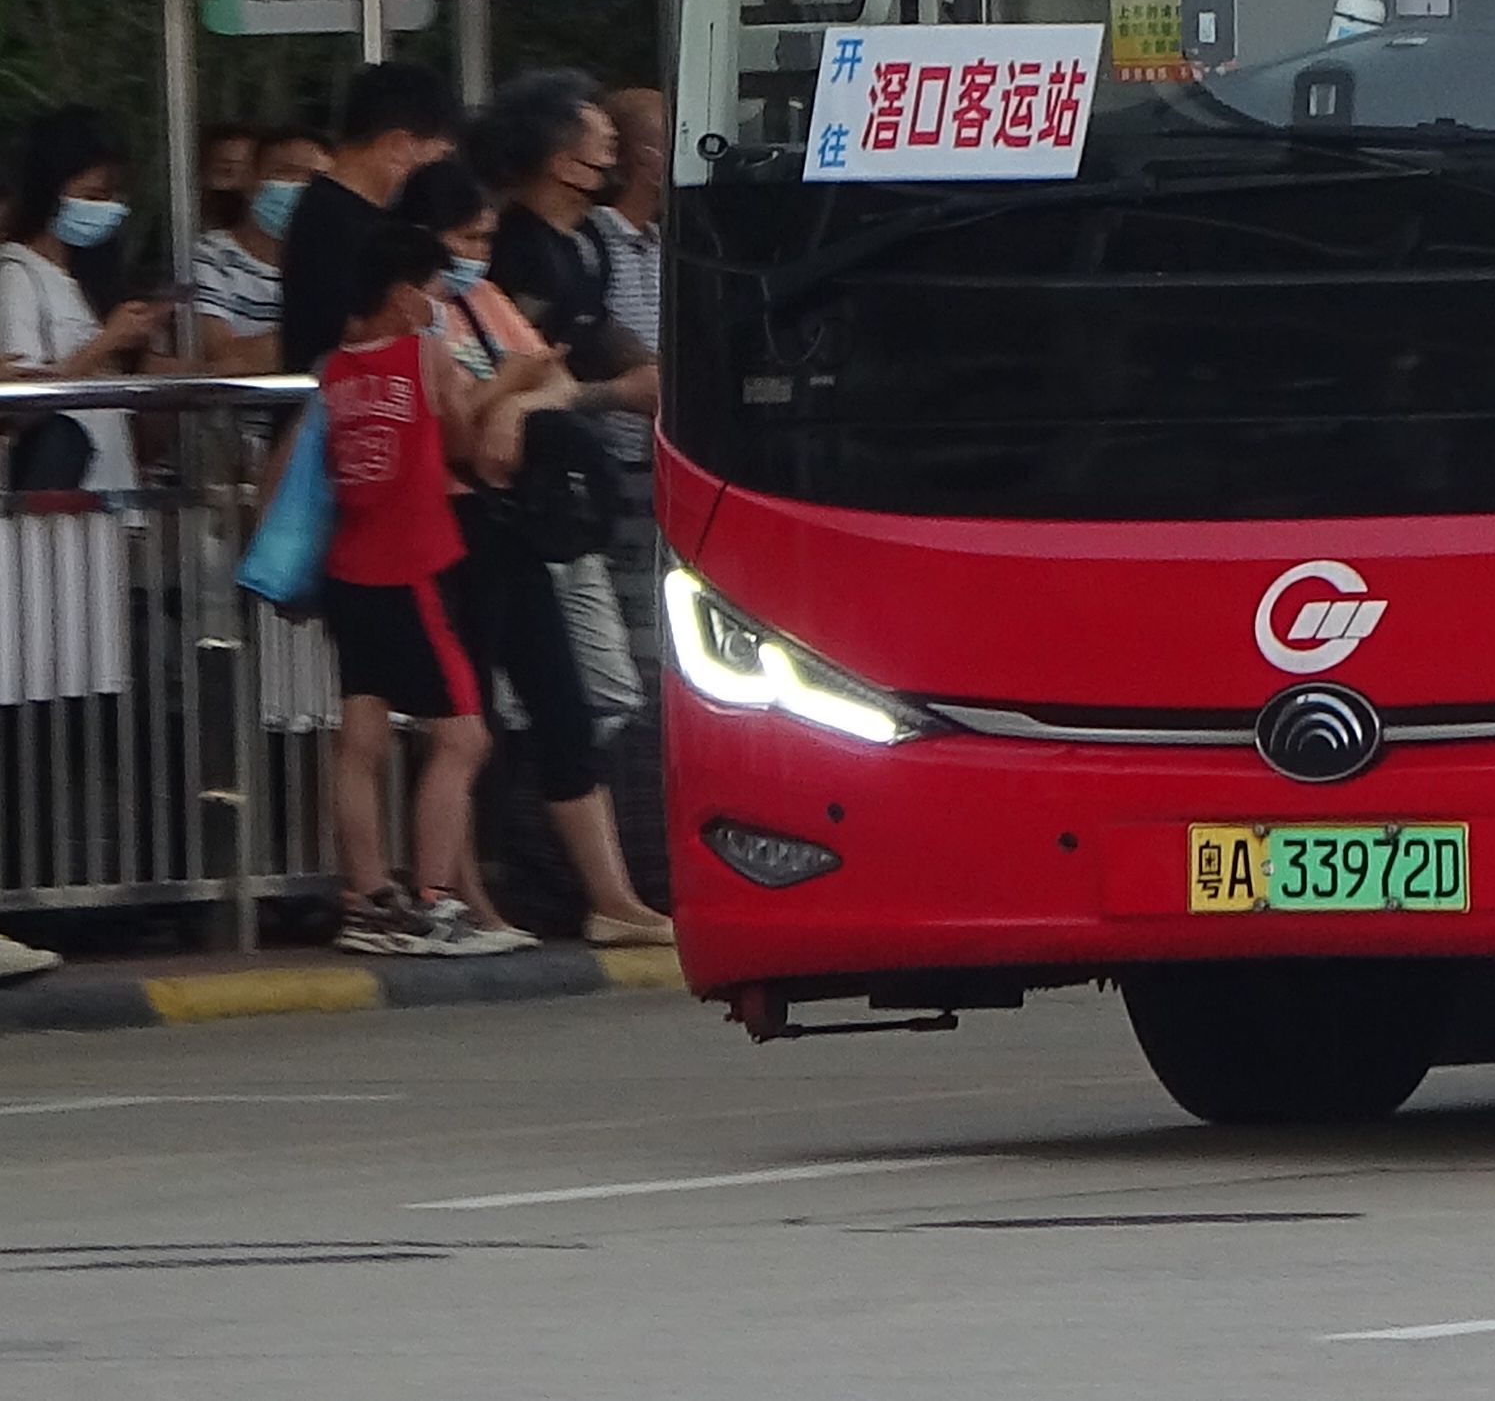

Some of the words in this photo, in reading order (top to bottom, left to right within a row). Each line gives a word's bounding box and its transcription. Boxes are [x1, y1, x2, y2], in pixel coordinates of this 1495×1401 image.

[817, 38, 863, 169] 开往
[861, 58, 1087, 151] 滘口客运站
[1197, 839, 1254, 900] 粤A
[1281, 838, 1460, 899] 33972D
